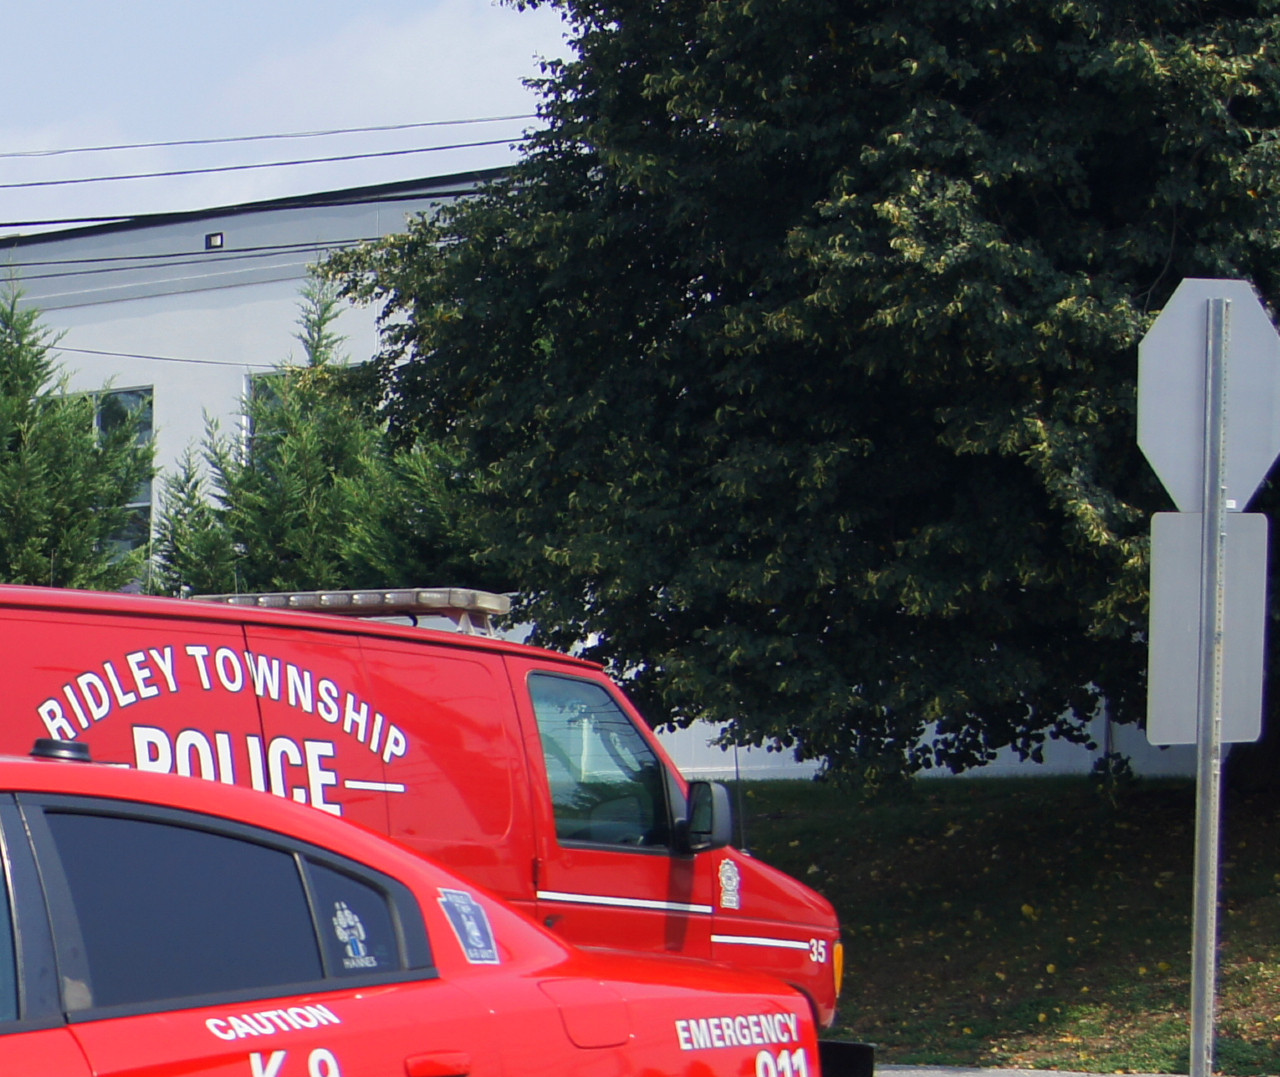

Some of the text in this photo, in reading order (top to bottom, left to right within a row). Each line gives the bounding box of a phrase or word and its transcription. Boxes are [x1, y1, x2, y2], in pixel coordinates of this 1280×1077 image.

[37, 644, 408, 764] RIDLEY TOWNSHIP
[809, 938, 827, 962] 35
[205, 1004, 342, 1041] CAUTION
[675, 1013, 798, 1050] EMERGENCY
